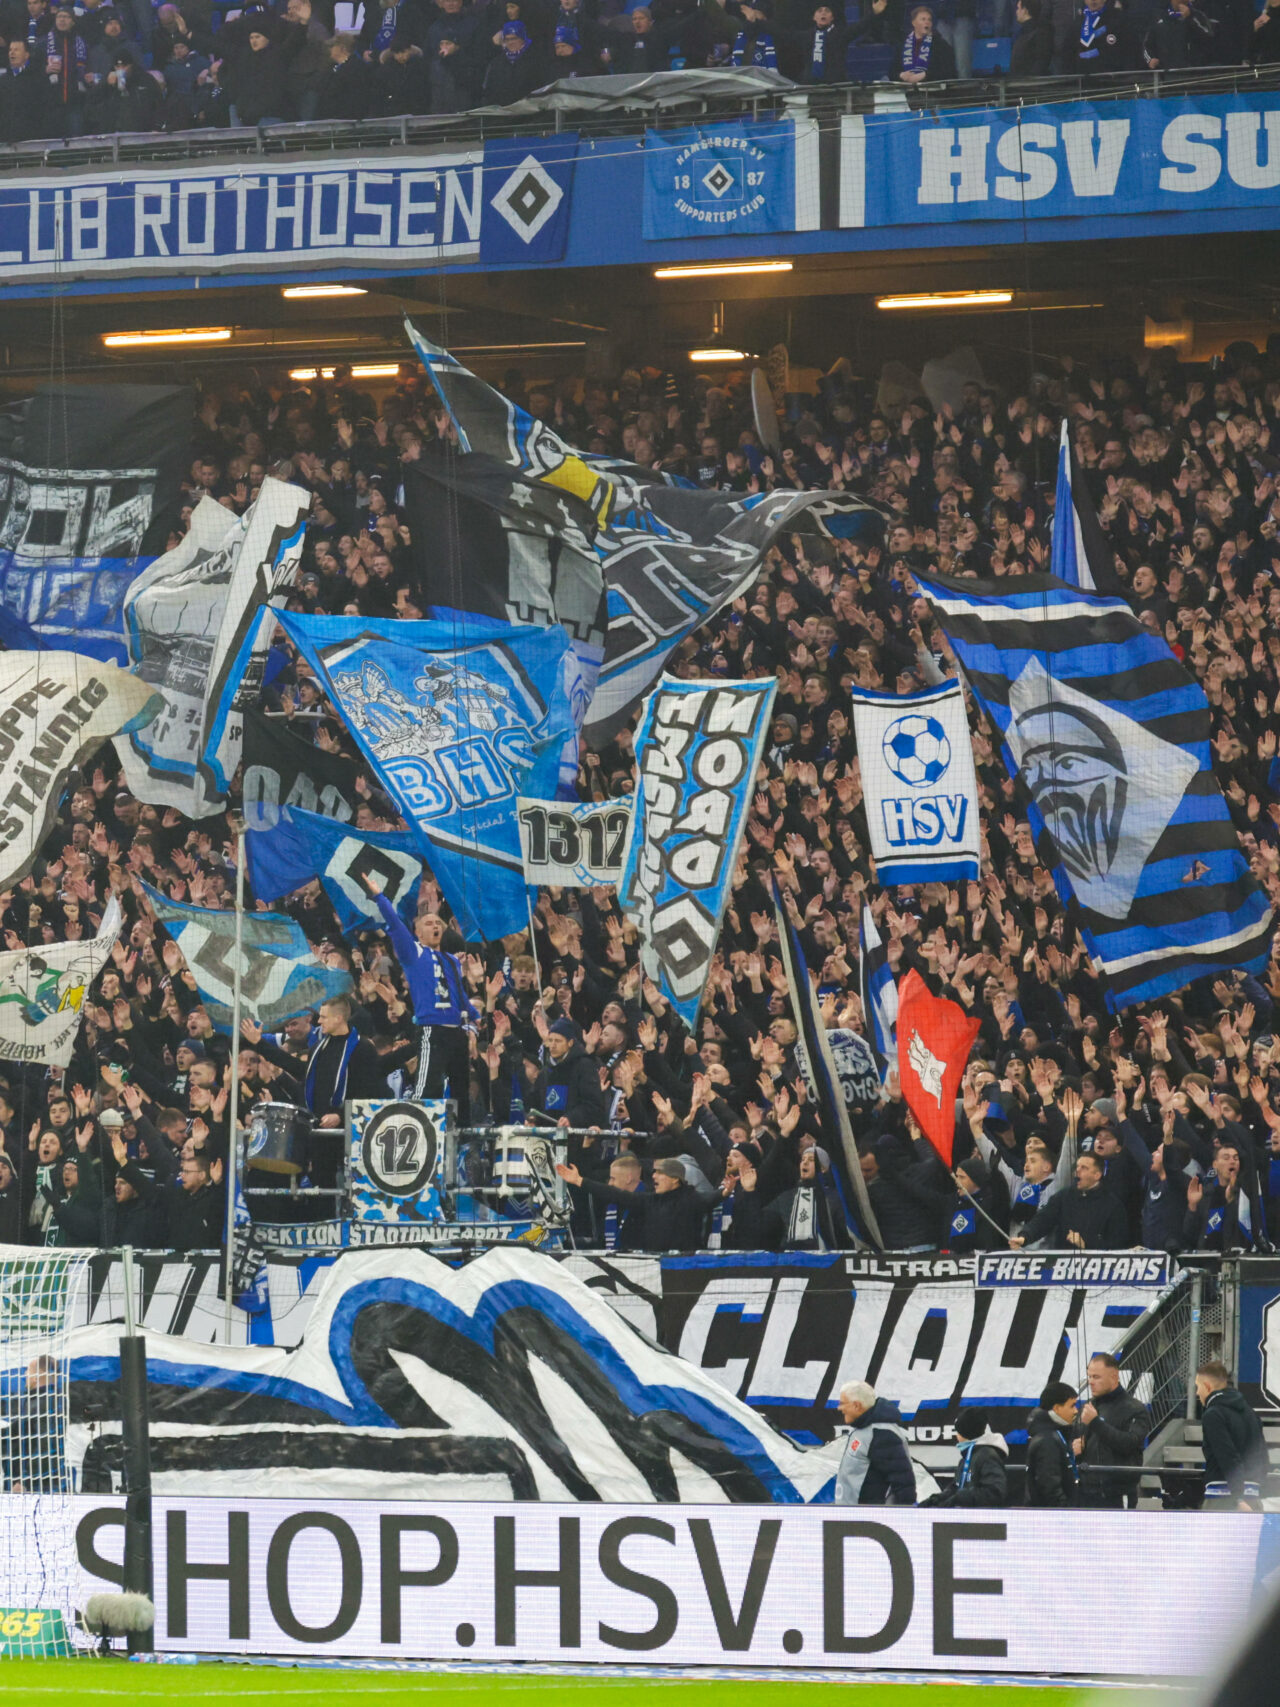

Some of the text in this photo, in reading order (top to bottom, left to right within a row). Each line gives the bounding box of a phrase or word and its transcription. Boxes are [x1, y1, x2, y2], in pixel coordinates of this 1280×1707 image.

[676, 137, 766, 166] HAMBURGER SV
[917, 110, 1280, 204] HSV SU
[674, 175, 691, 190] 18
[747, 171, 766, 186] 87
[134, 166, 483, 256] ROTHOSEN
[674, 194, 765, 223] SUPPORTERS CLUB
[520, 806, 632, 870] 1312
[881, 794, 968, 847] HSV
[375, 1126, 421, 1176] 12
[254, 1223, 342, 1246] SEKTION
[845, 1257, 977, 1278] ULTRAS
[980, 1256, 1165, 1282] FREE BRATANS
[678, 1277, 1162, 1413] CLIQUE
[76, 1507, 1009, 1657] SHOP.HSV.DE
